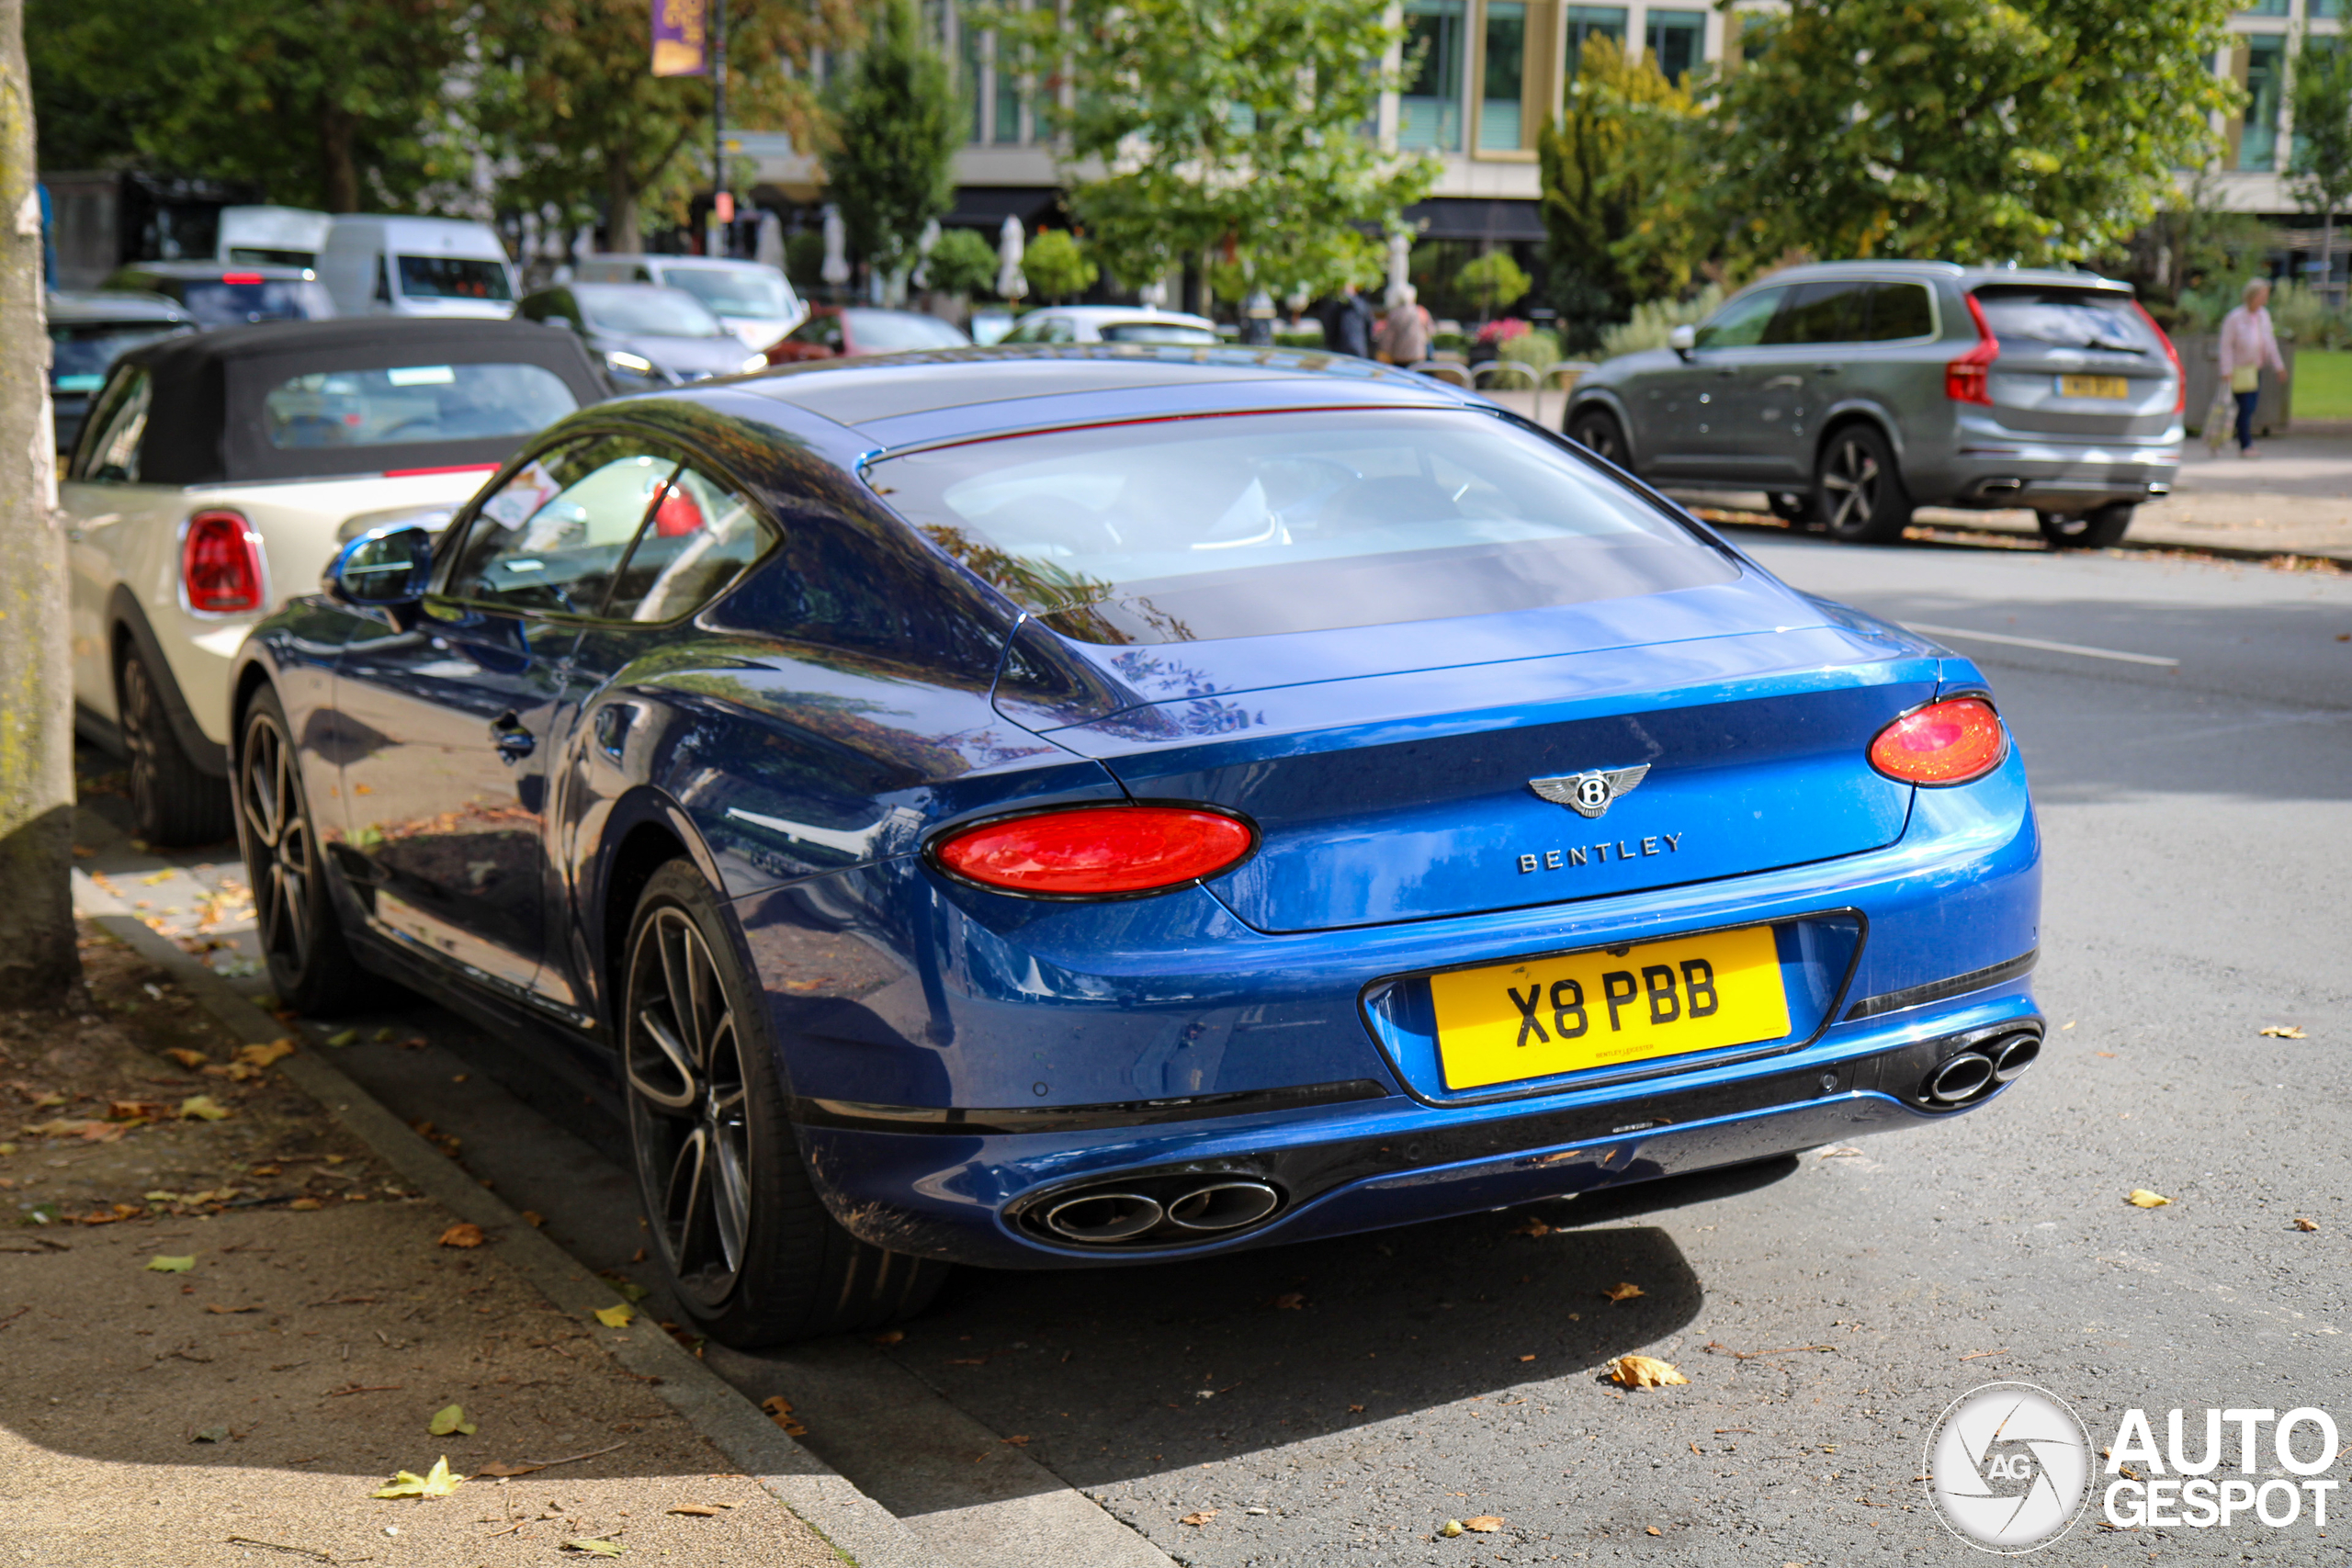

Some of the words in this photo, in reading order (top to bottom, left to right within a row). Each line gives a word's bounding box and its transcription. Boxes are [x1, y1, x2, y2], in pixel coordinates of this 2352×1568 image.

[1581, 779, 1606, 806] B
[1519, 831, 1682, 874] BENTLEY
[1507, 978, 1589, 1047] X8
[1601, 958, 1719, 1032] PBB
[1596, 1050, 1622, 1058] BENTLEY
[1623, 1043, 1654, 1055] LEICESTER
